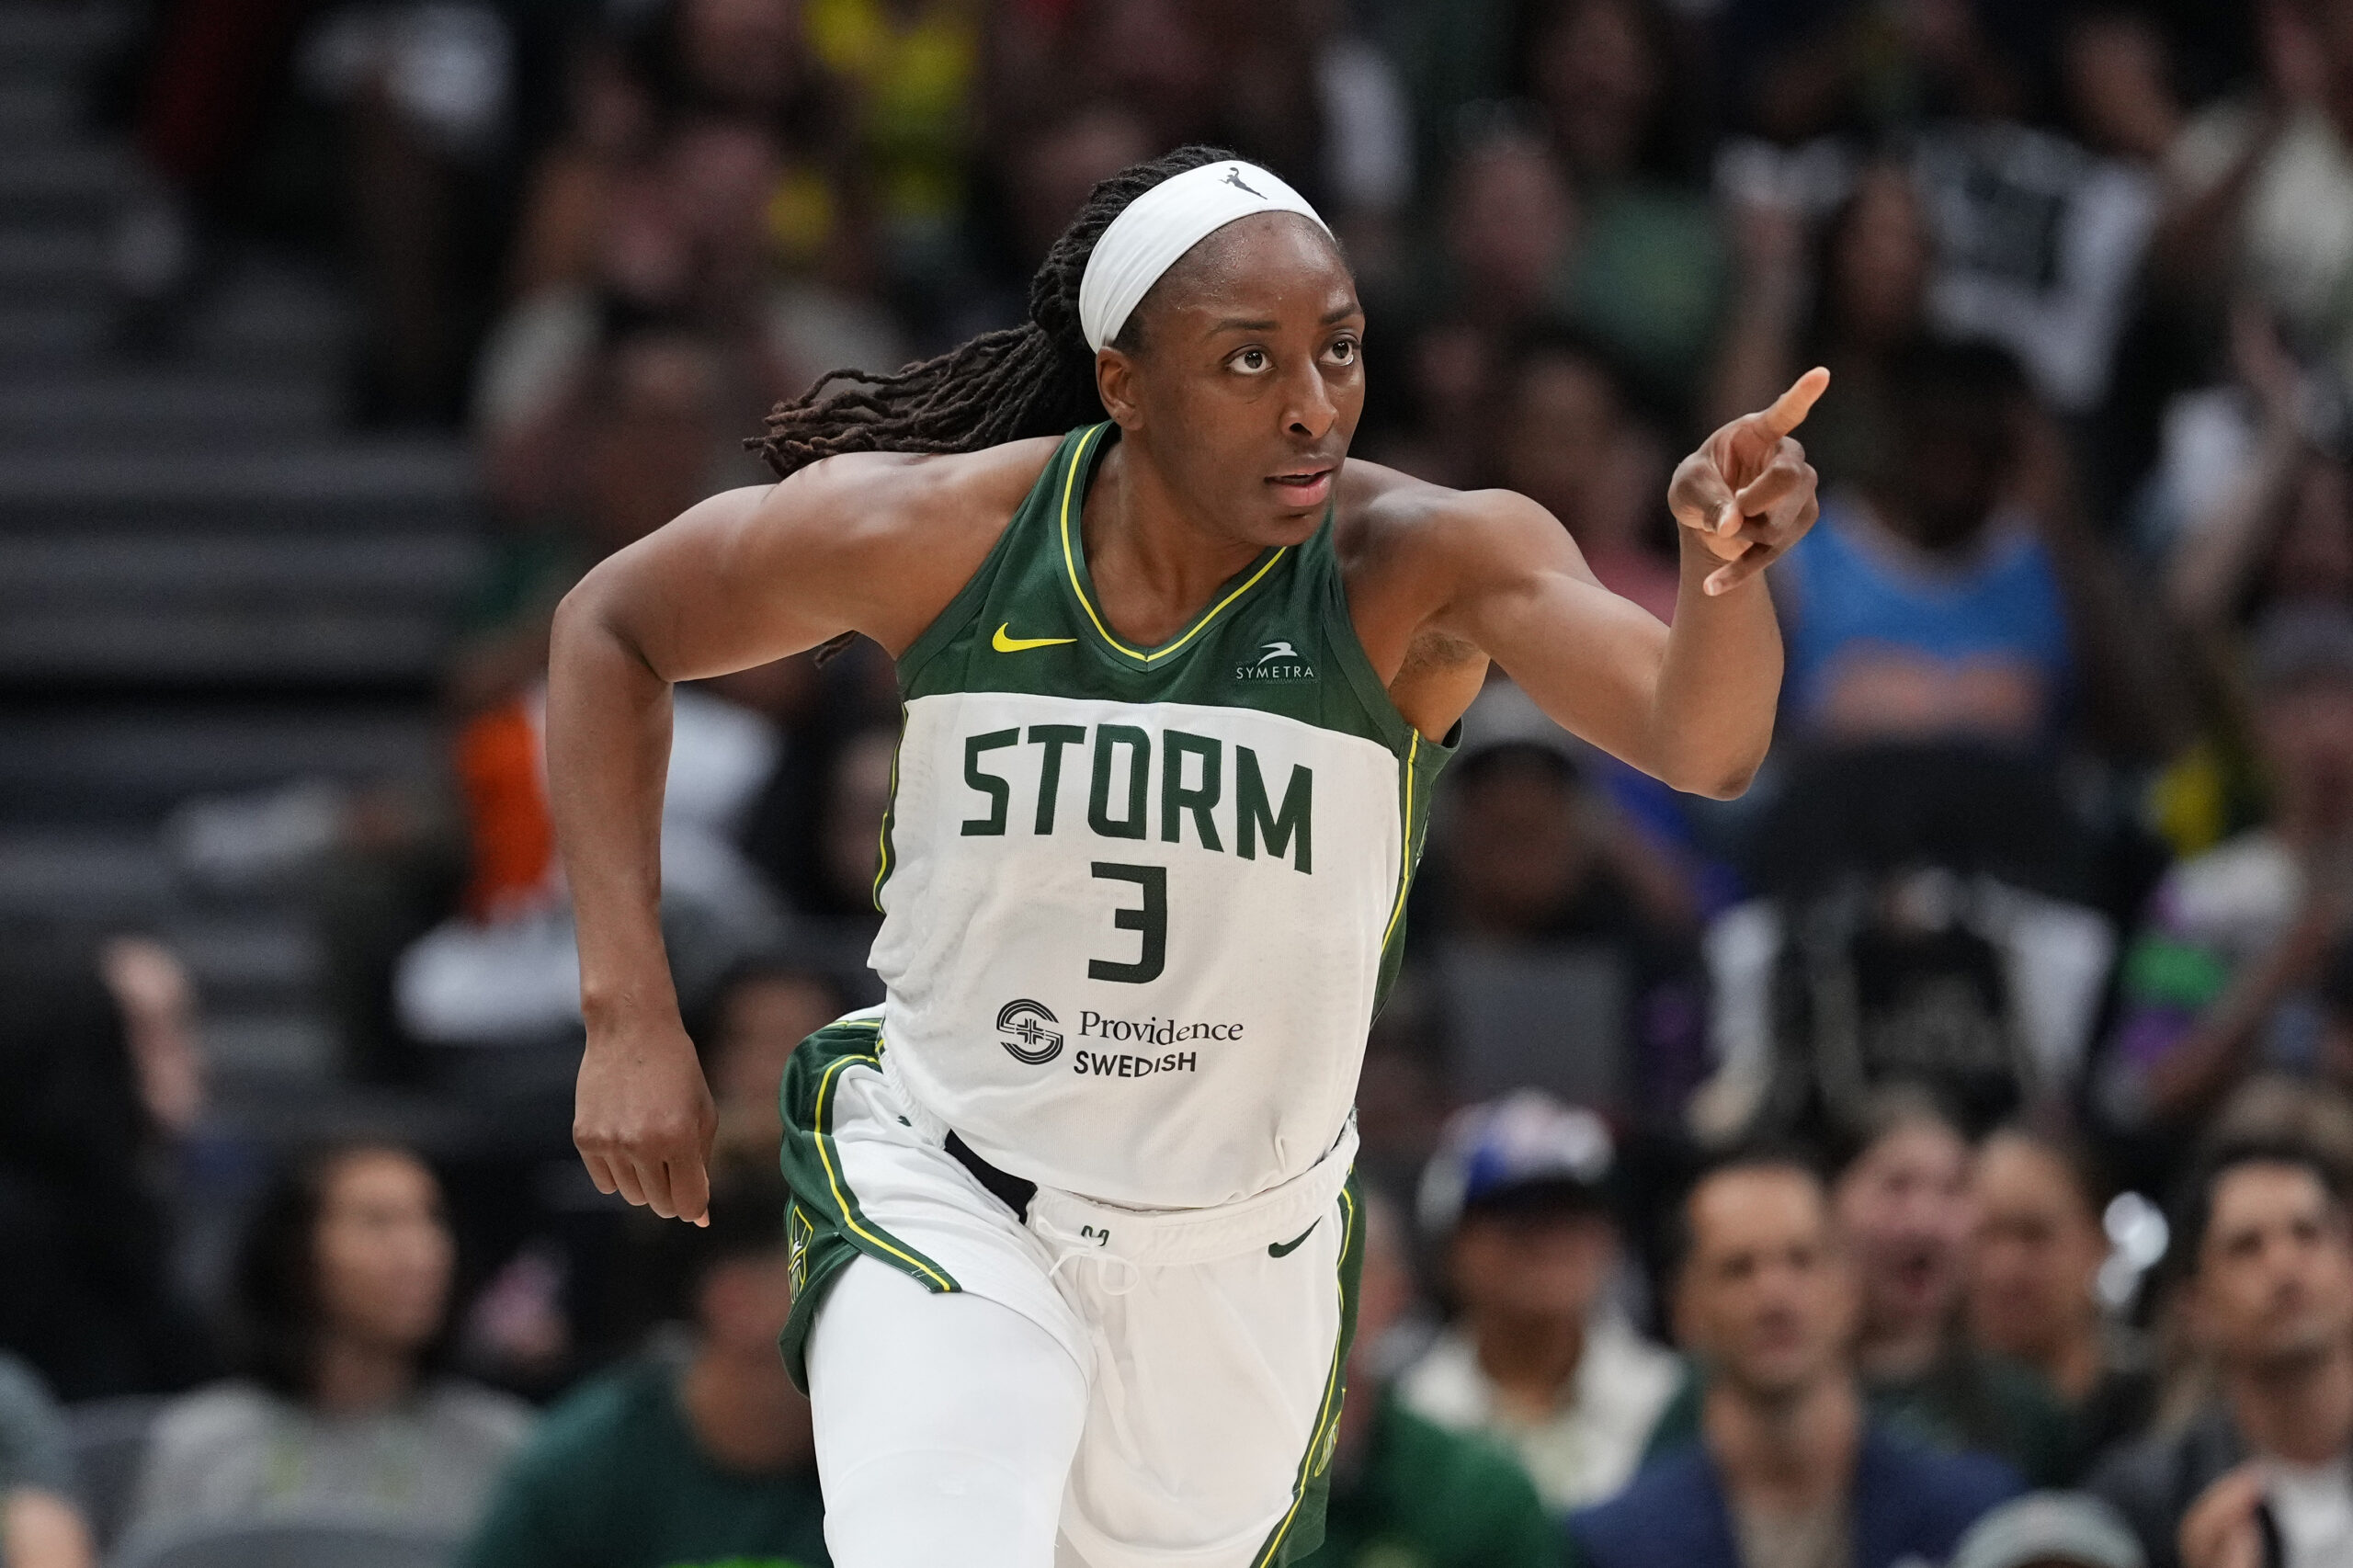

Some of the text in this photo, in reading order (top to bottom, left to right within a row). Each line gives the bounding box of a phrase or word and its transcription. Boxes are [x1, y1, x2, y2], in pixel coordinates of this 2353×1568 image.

[1235, 665, 1314, 679] SYMETRA
[960, 723, 1313, 876] STORM
[1087, 861, 1168, 984] 3
[1078, 1010, 1244, 1046] Providence
[1073, 1050, 1197, 1078] SWEDISH
